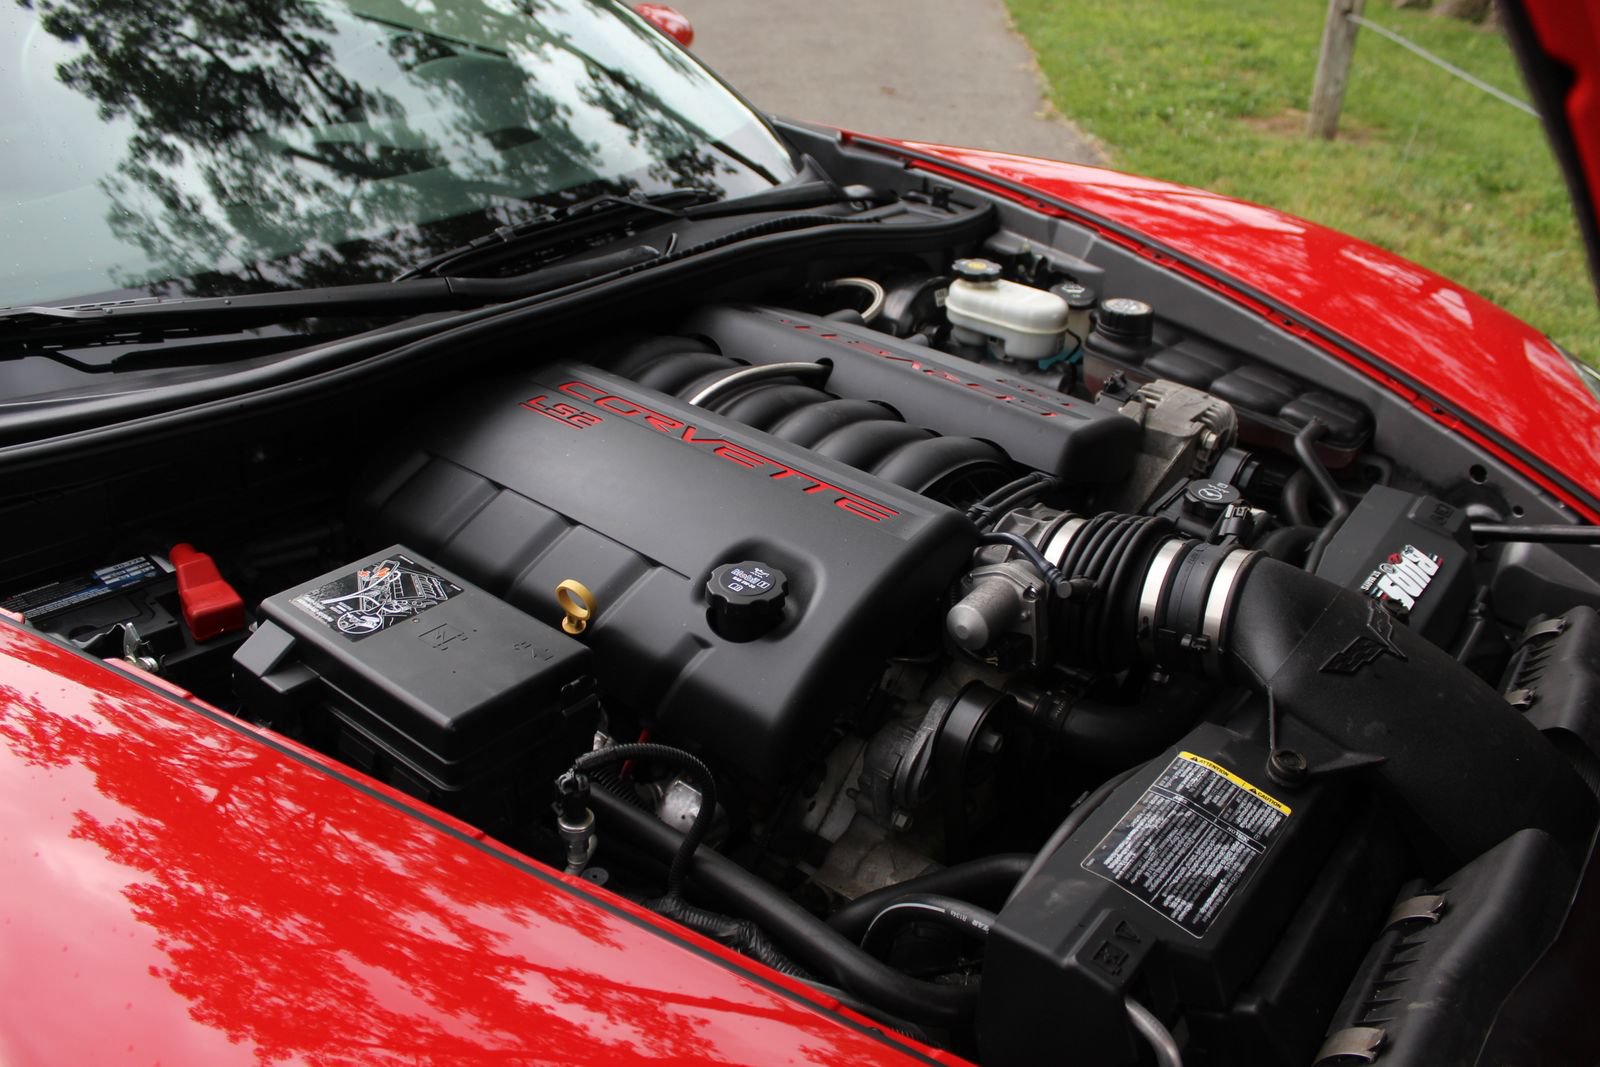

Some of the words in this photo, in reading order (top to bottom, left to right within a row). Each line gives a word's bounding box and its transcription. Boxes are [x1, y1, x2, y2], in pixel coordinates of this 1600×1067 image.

[519, 395, 604, 430] LS2
[557, 380, 900, 522] CORVETTE
[1198, 758, 1229, 777] ATTENTION
[1257, 792, 1282, 809] CAUTION
